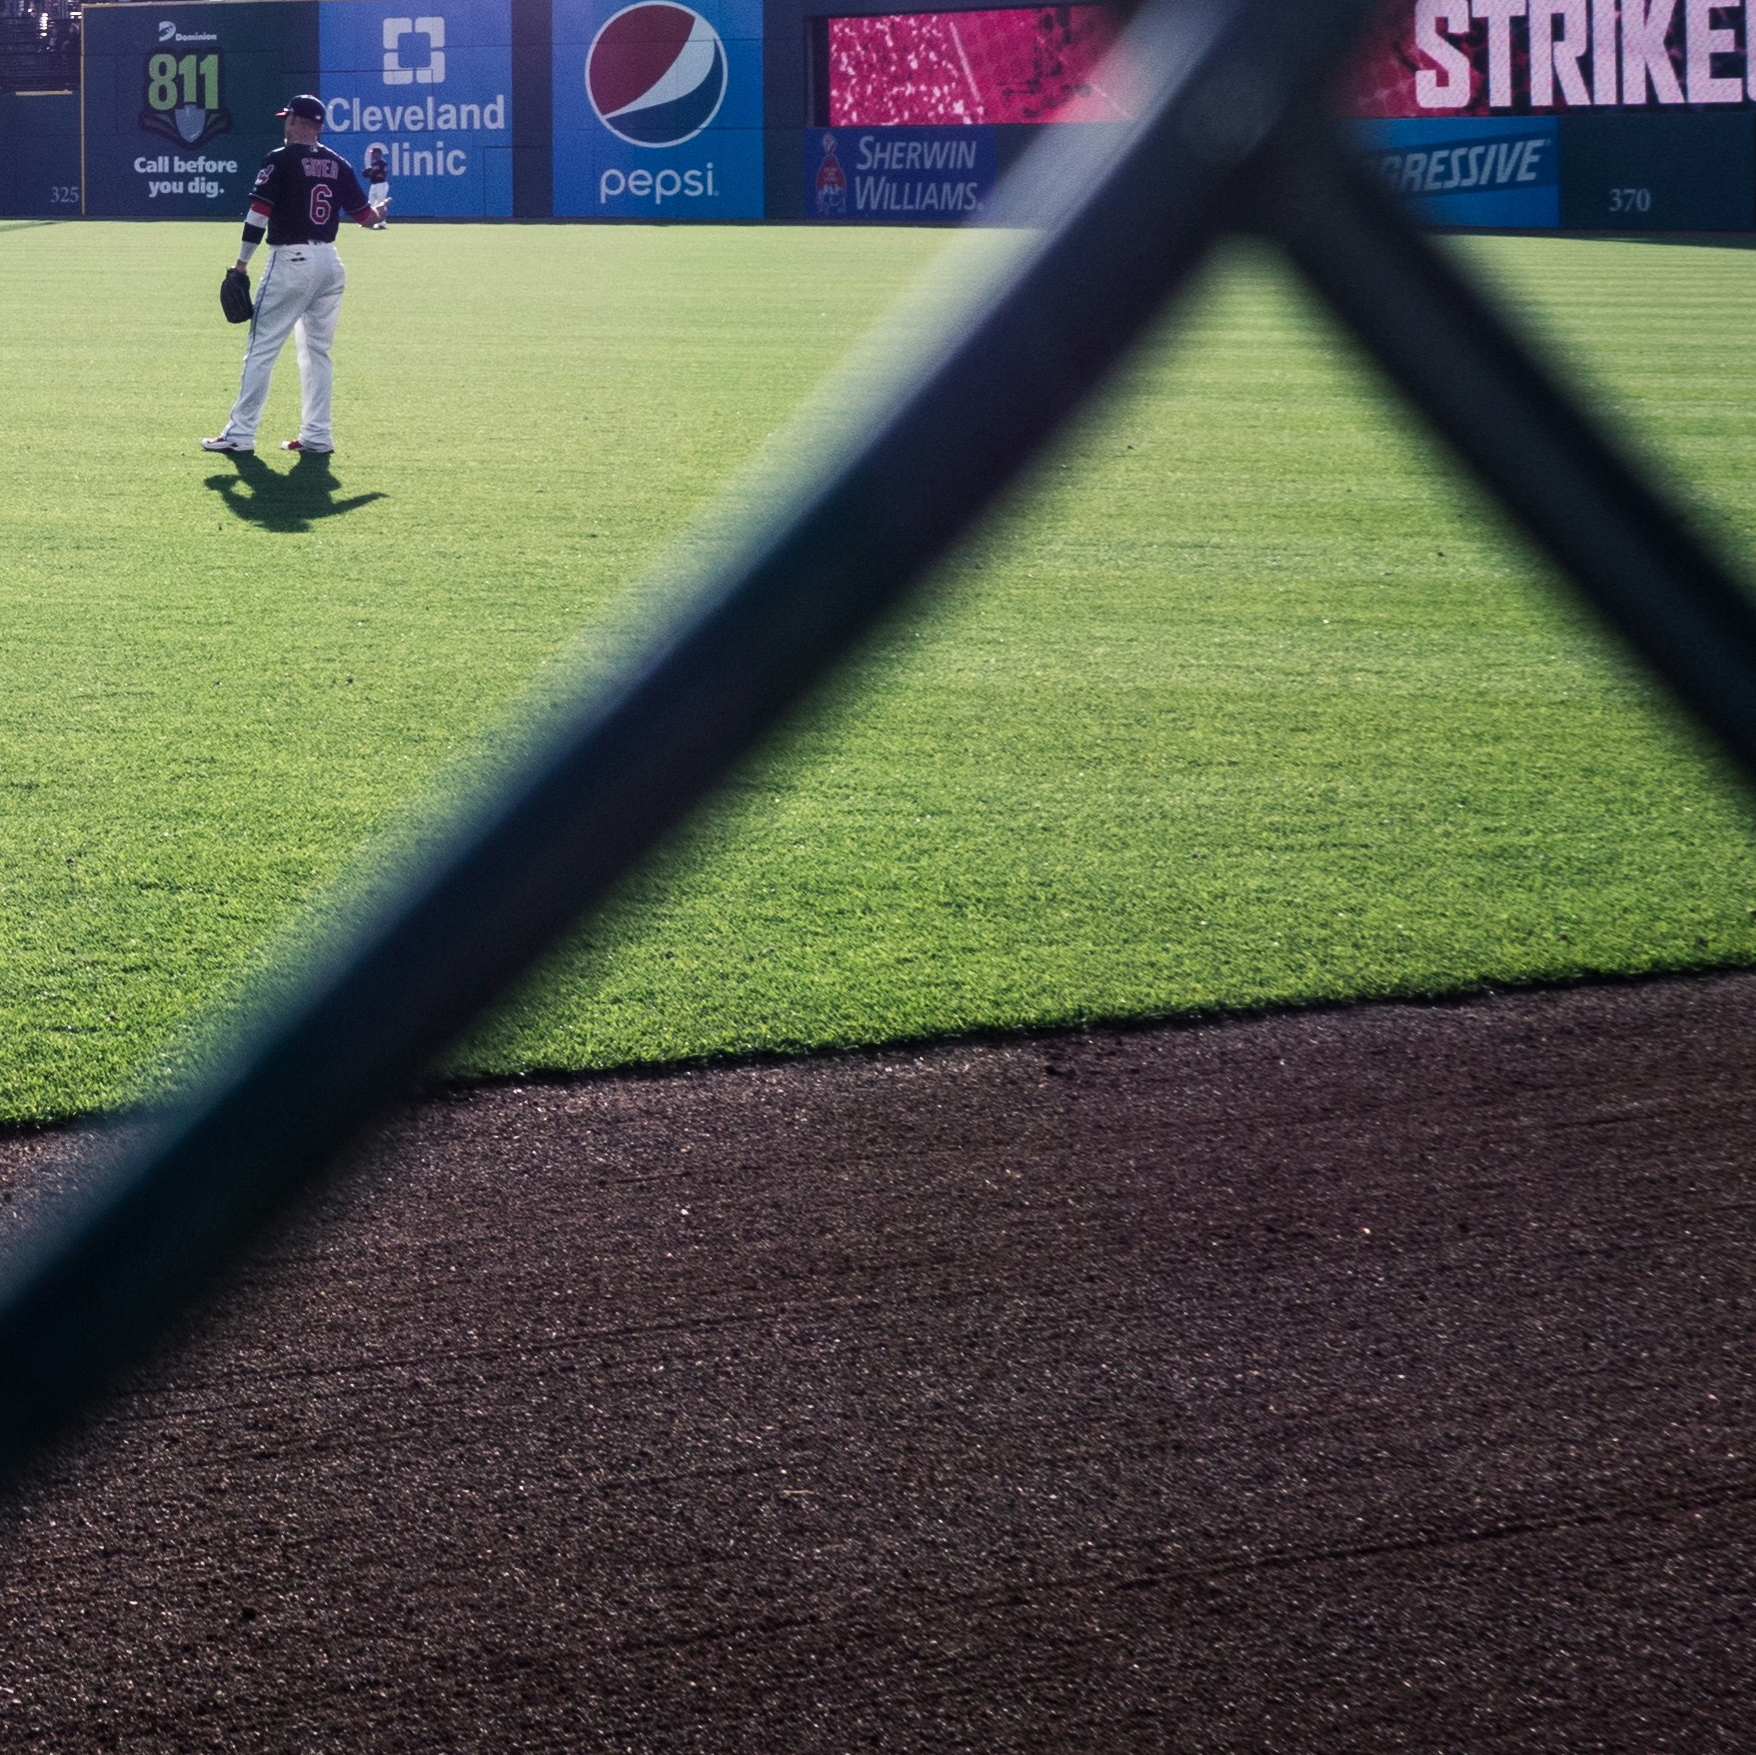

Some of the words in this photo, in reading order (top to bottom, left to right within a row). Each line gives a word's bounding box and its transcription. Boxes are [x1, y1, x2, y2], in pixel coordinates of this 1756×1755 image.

[176, 32, 217, 41] Dominion
[148, 54, 219, 111] 811
[325, 94, 506, 132] Cleveland
[134, 156, 169, 173] Call
[173, 156, 238, 173] before
[301, 157, 338, 180] GUYER
[363, 139, 467, 177] Clinic
[856, 135, 977, 171] SHERWIN
[51, 186, 79, 203] 325
[149, 180, 183, 198] you
[187, 177, 225, 198] dig.
[599, 161, 715, 205] pepsi
[855, 176, 978, 211] WILLIAMS
[1608, 188, 1651, 213] 370
[309, 184, 333, 225] 6
